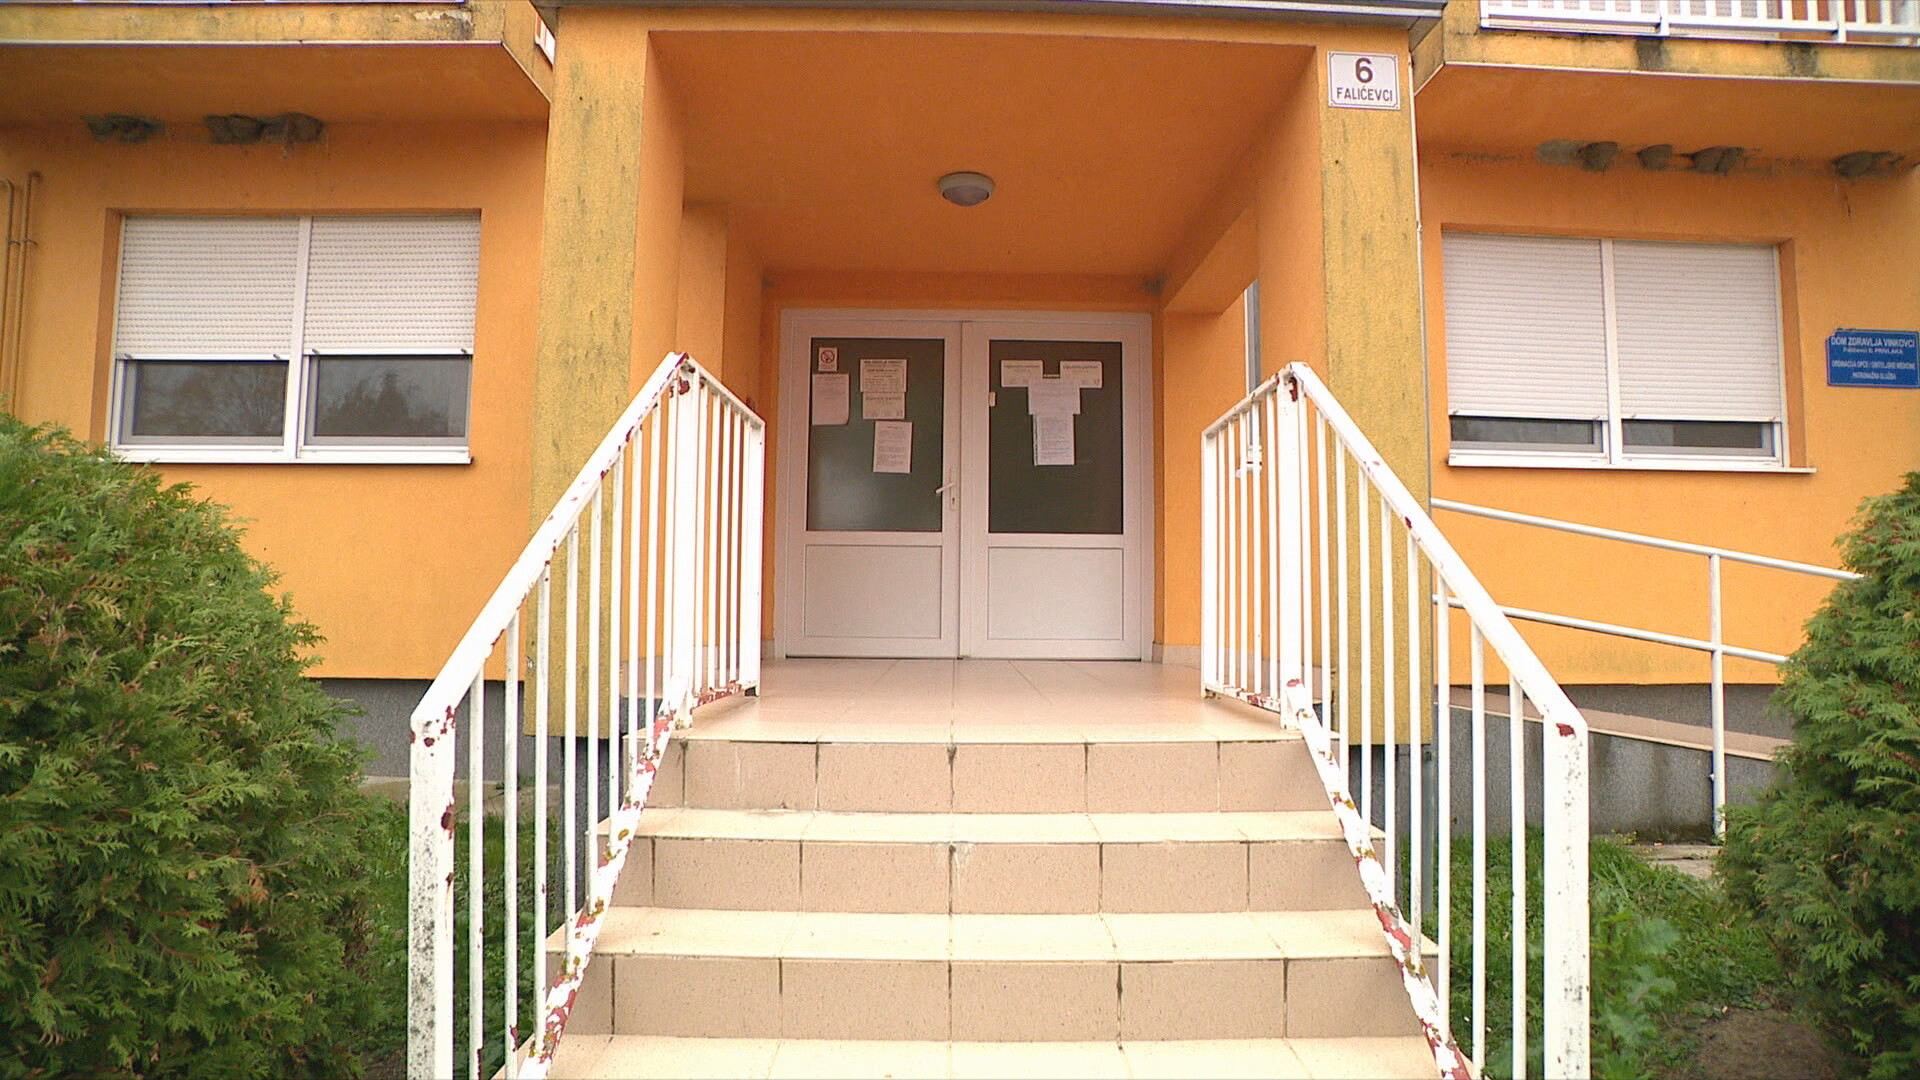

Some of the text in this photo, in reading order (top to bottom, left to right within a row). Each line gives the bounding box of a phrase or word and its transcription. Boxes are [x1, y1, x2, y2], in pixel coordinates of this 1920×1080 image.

[1355, 57, 1373, 84] 6
[1831, 336, 1915, 348] DOM ZDRAVLJA VINKOVCI
